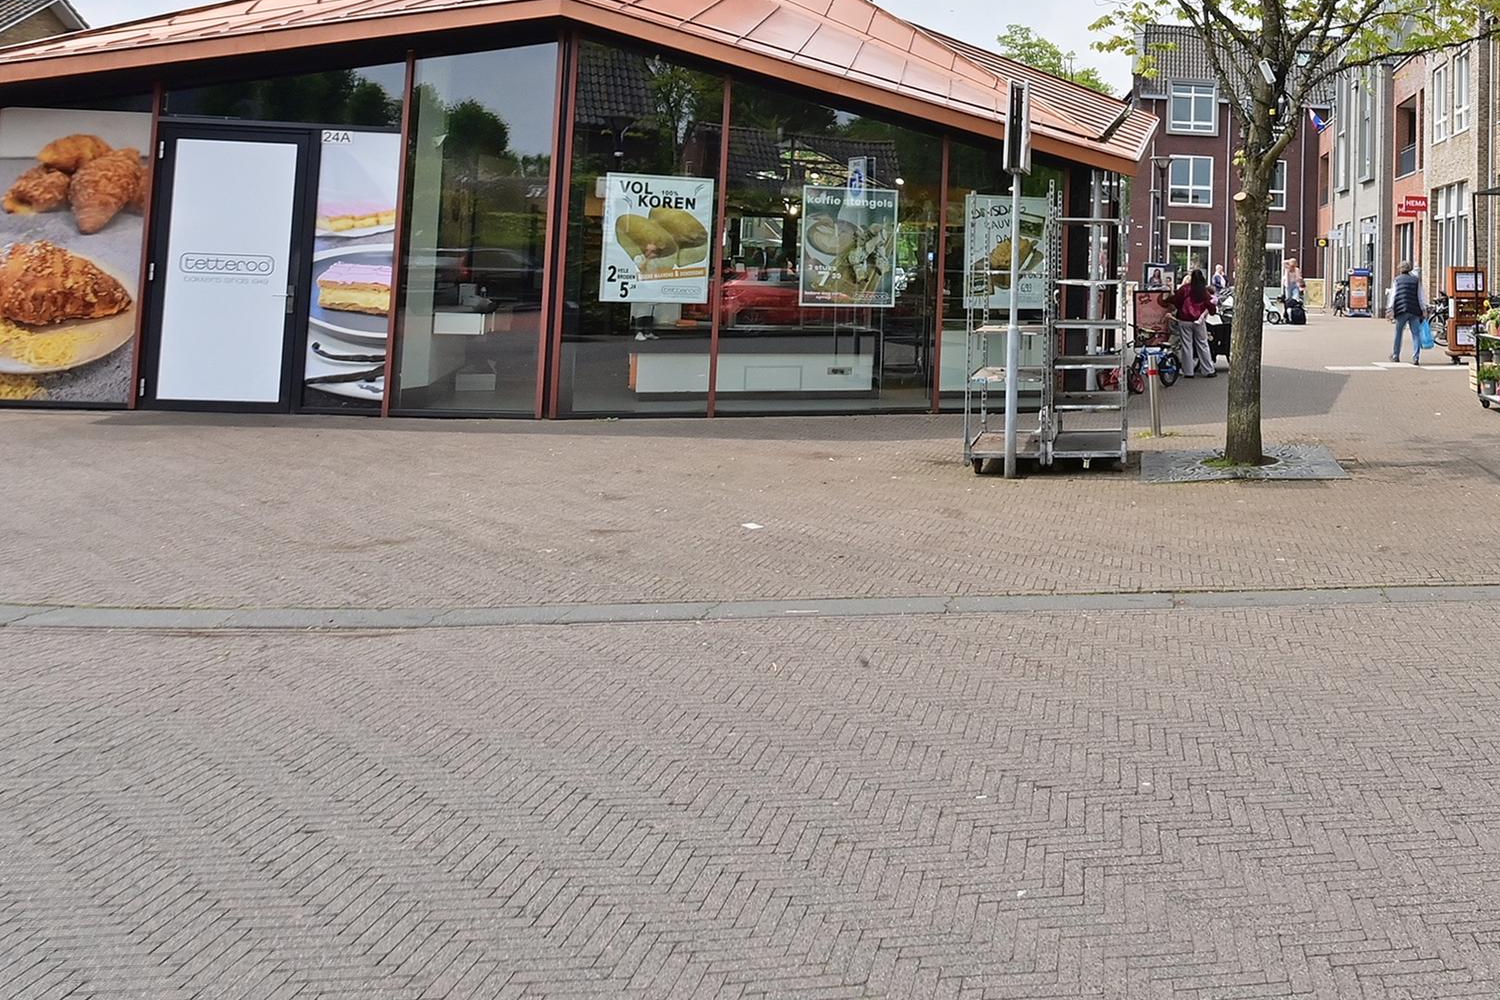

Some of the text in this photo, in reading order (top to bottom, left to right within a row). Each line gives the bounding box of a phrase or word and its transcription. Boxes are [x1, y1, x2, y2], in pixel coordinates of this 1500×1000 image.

[323, 131, 351, 143] 24A
[620, 180, 654, 195] VOL
[638, 195, 696, 210] KOREN
[807, 194, 841, 206] koffie
[185, 258, 270, 272] tetteroo
[607, 265, 617, 283] 2
